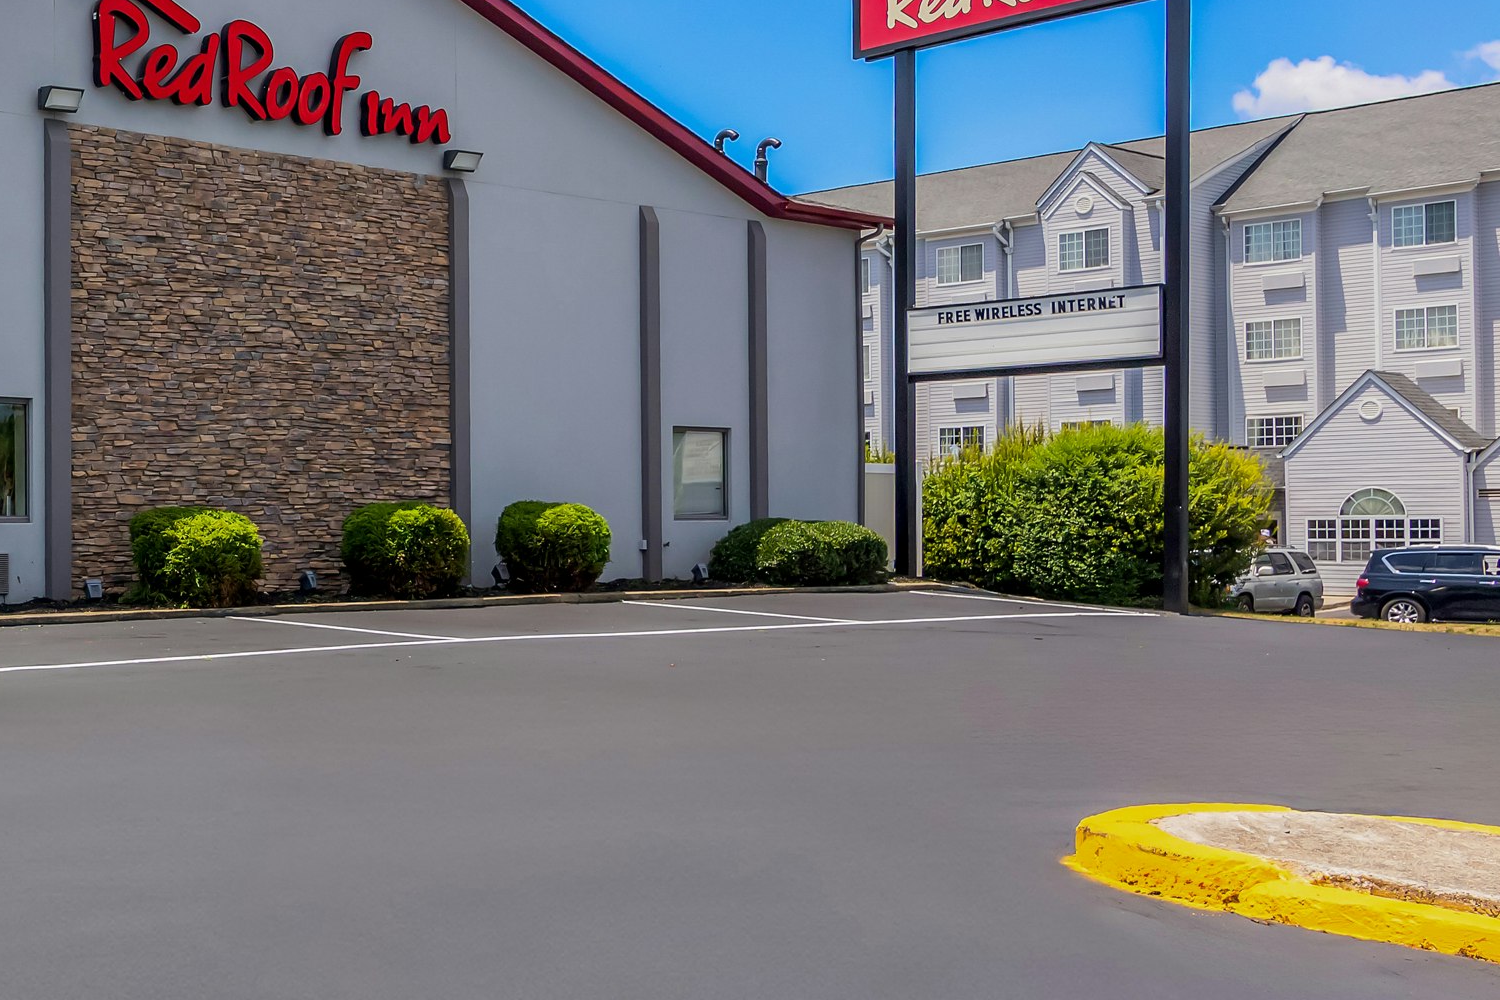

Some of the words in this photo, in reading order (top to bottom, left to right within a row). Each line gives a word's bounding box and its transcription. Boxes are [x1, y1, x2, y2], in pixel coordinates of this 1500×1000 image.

[220, 19, 372, 136] Roof
[937, 309, 971, 325] FREE
[974, 302, 1042, 321] WIRELESS
[1051, 294, 1125, 314] INTERNET
